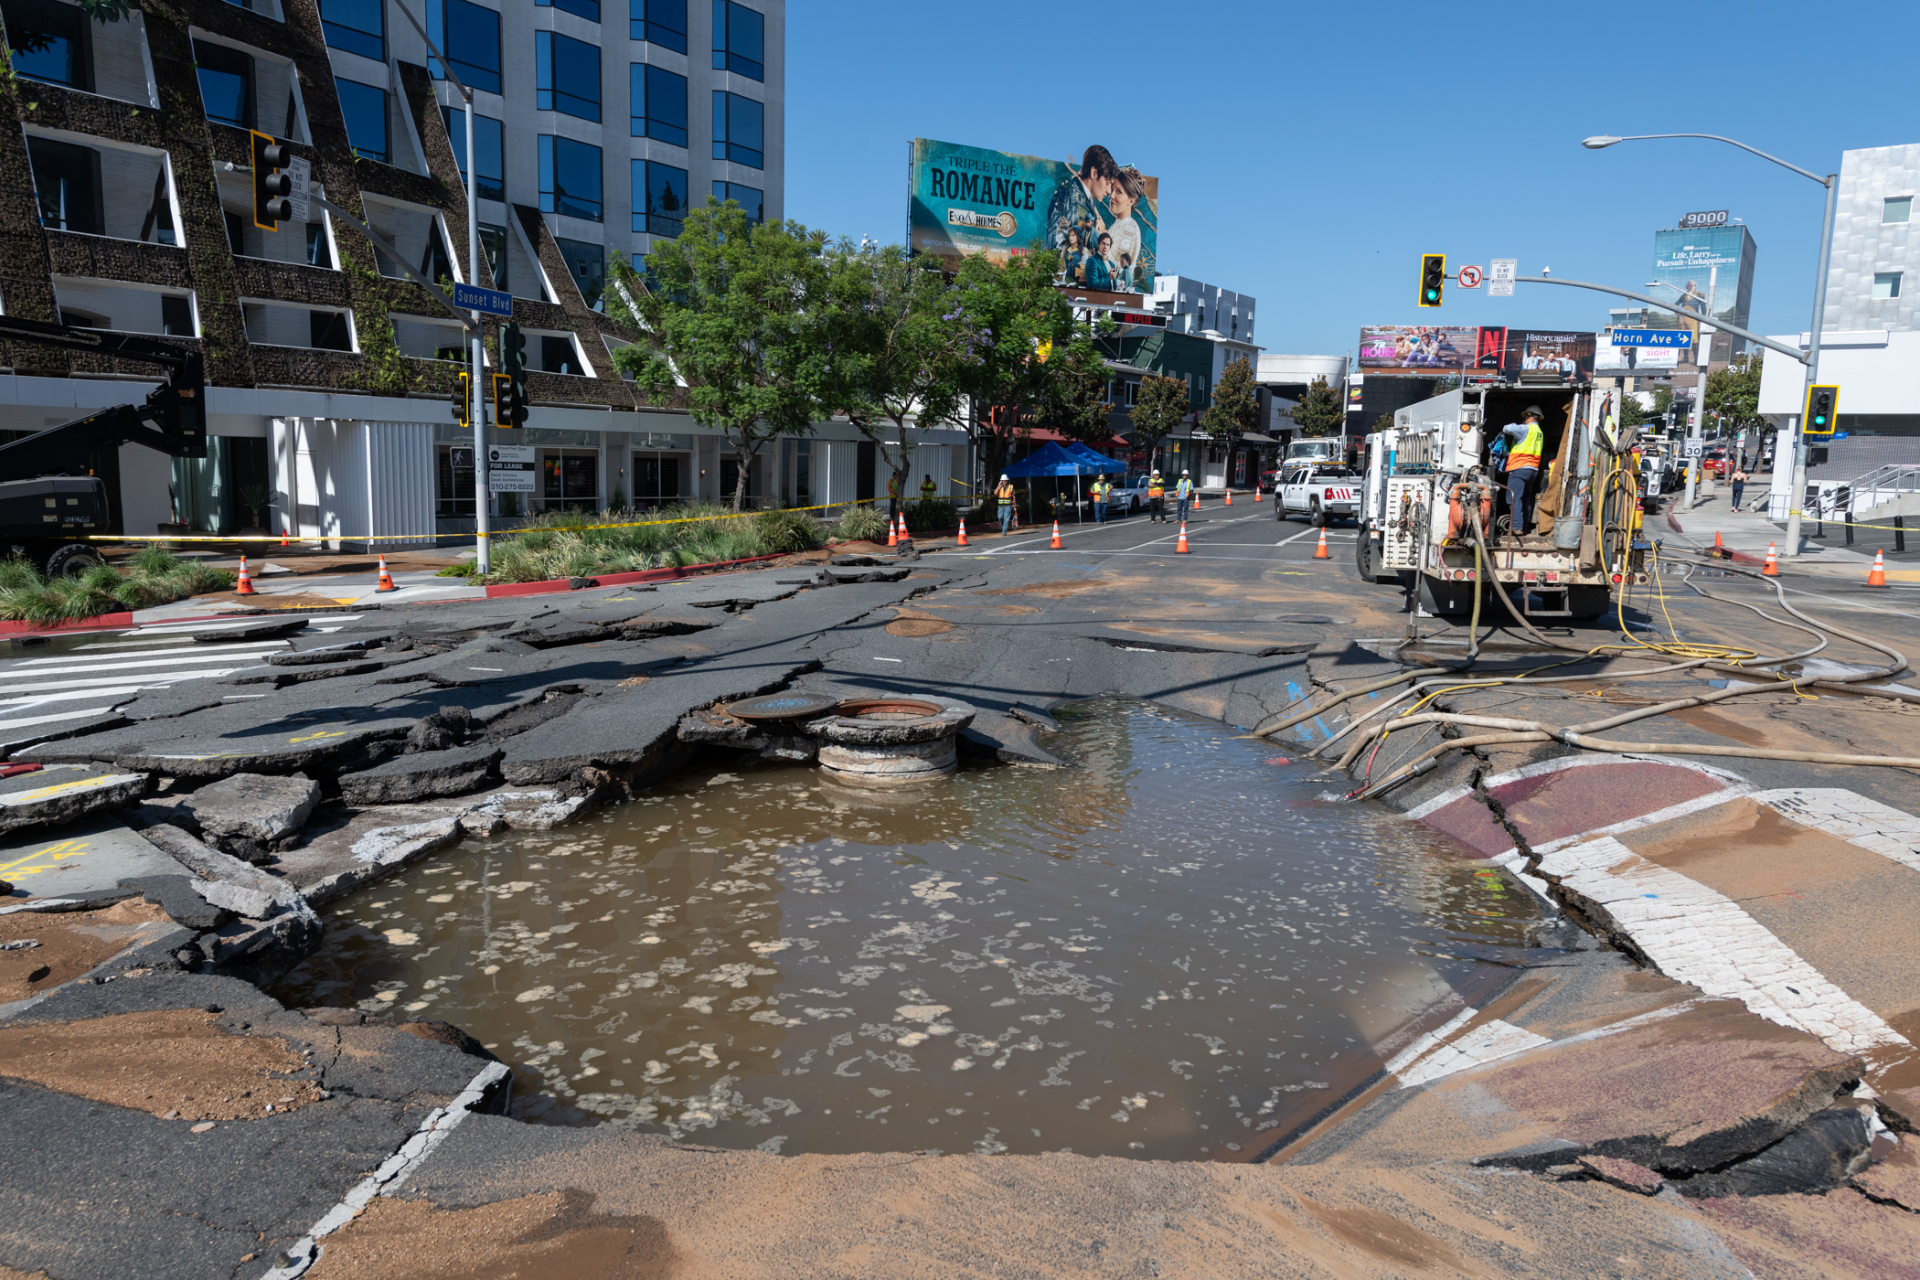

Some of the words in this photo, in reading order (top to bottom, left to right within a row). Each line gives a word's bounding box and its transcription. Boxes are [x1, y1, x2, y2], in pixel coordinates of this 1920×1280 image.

[948, 155, 990, 173] TRIPLE
[993, 163, 1018, 176] THE
[291, 180, 302, 190] LOCK
[930, 168, 1036, 210] ROMANCE
[1687, 212, 1726, 224] 9000
[1002, 217, 1011, 233] 3
[922, 238, 943, 247] WATCH
[957, 242, 982, 251] TRILOGY
[1688, 257, 1736, 266] Unhappiness
[458, 290, 487, 307] Sunset
[492, 296, 510, 311] Blvd
[1124, 313, 1152, 325] NETFLIX
[1373, 340, 1386, 348] 72
[1526, 334, 1553, 343] History,
[1554, 335, 1576, 344] again?
[1614, 333, 1642, 343] Horn
[1650, 334, 1672, 344] Ave
[1362, 347, 1396, 358] HOURS
